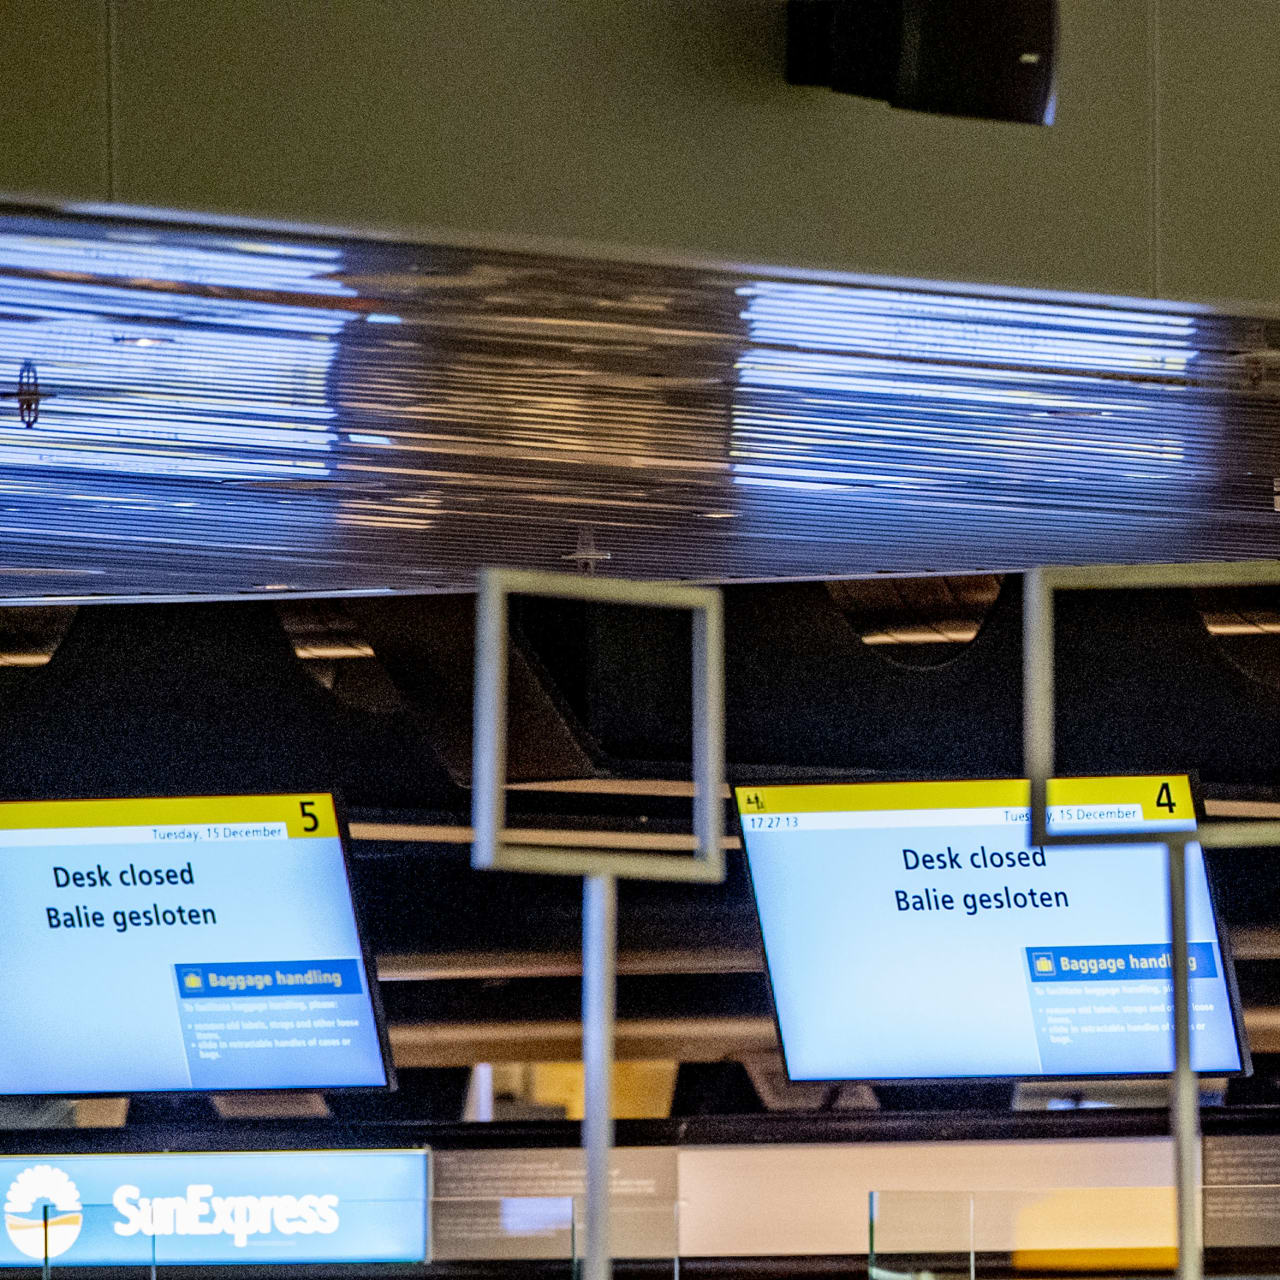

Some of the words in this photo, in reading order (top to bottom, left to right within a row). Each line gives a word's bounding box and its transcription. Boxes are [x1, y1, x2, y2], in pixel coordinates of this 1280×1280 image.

[1156, 782, 1176, 813] 4
[299, 801, 319, 833] 5
[1004, 810, 1055, 824] Tuesy,
[1060, 809, 1073, 821] 15
[1077, 809, 1136, 821] December
[152, 828, 203, 840] Tuesday,
[206, 827, 220, 838] 15
[223, 826, 282, 838] December
[902, 846, 961, 870] Desk
[970, 846, 1047, 869] closed
[53, 864, 113, 888] Desk
[119, 862, 195, 888] closed
[895, 888, 954, 912] Balie
[963, 885, 1070, 916] gesloten
[46, 906, 104, 929] Balie
[113, 903, 217, 933] gesloten
[1059, 956, 1125, 974] Baggage
[1129, 953, 1197, 971] handlg
[208, 972, 273, 990] Baggage
[275, 969, 343, 988] handling
[113, 1184, 340, 1248] SunExpress
